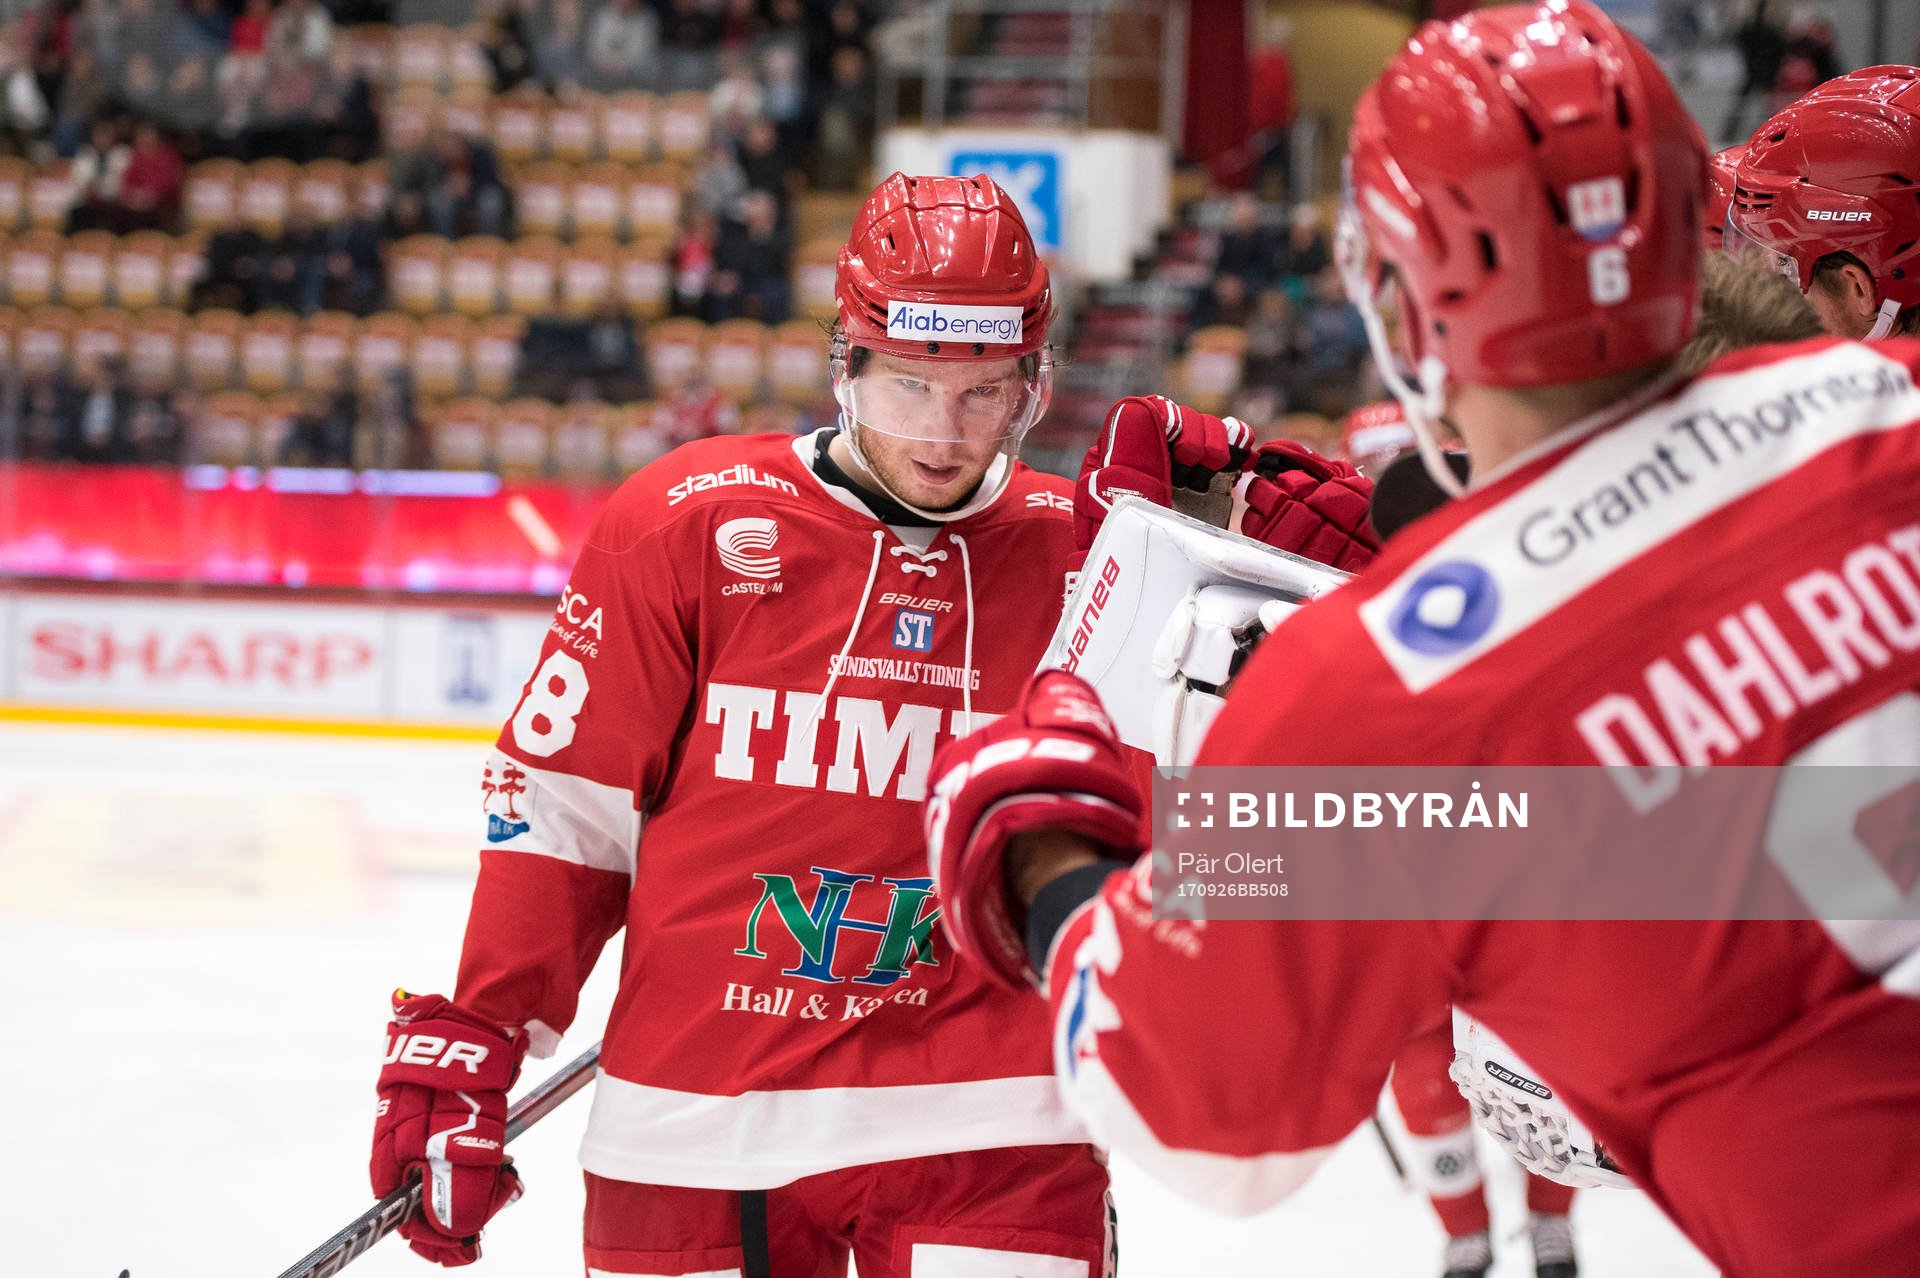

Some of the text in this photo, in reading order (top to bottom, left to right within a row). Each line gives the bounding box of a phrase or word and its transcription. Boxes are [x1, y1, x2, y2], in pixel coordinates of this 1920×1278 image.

[1806, 210, 1872, 221] BAUER
[1588, 248, 1631, 305] 6
[667, 464, 799, 506] stadium
[1517, 442, 1693, 568] Grant
[557, 584, 603, 641] SCA
[879, 592, 953, 612] BAUER
[1061, 555, 1120, 676] BAUER
[32, 620, 375, 687] SHARP
[573, 636, 599, 658] Life
[896, 611, 932, 649] ST
[512, 649, 590, 758] 8
[734, 866, 944, 984] NHK
[720, 983, 794, 1017] Hall
[800, 993, 829, 1020] &
[1488, 1063, 1549, 1098] BAUER
